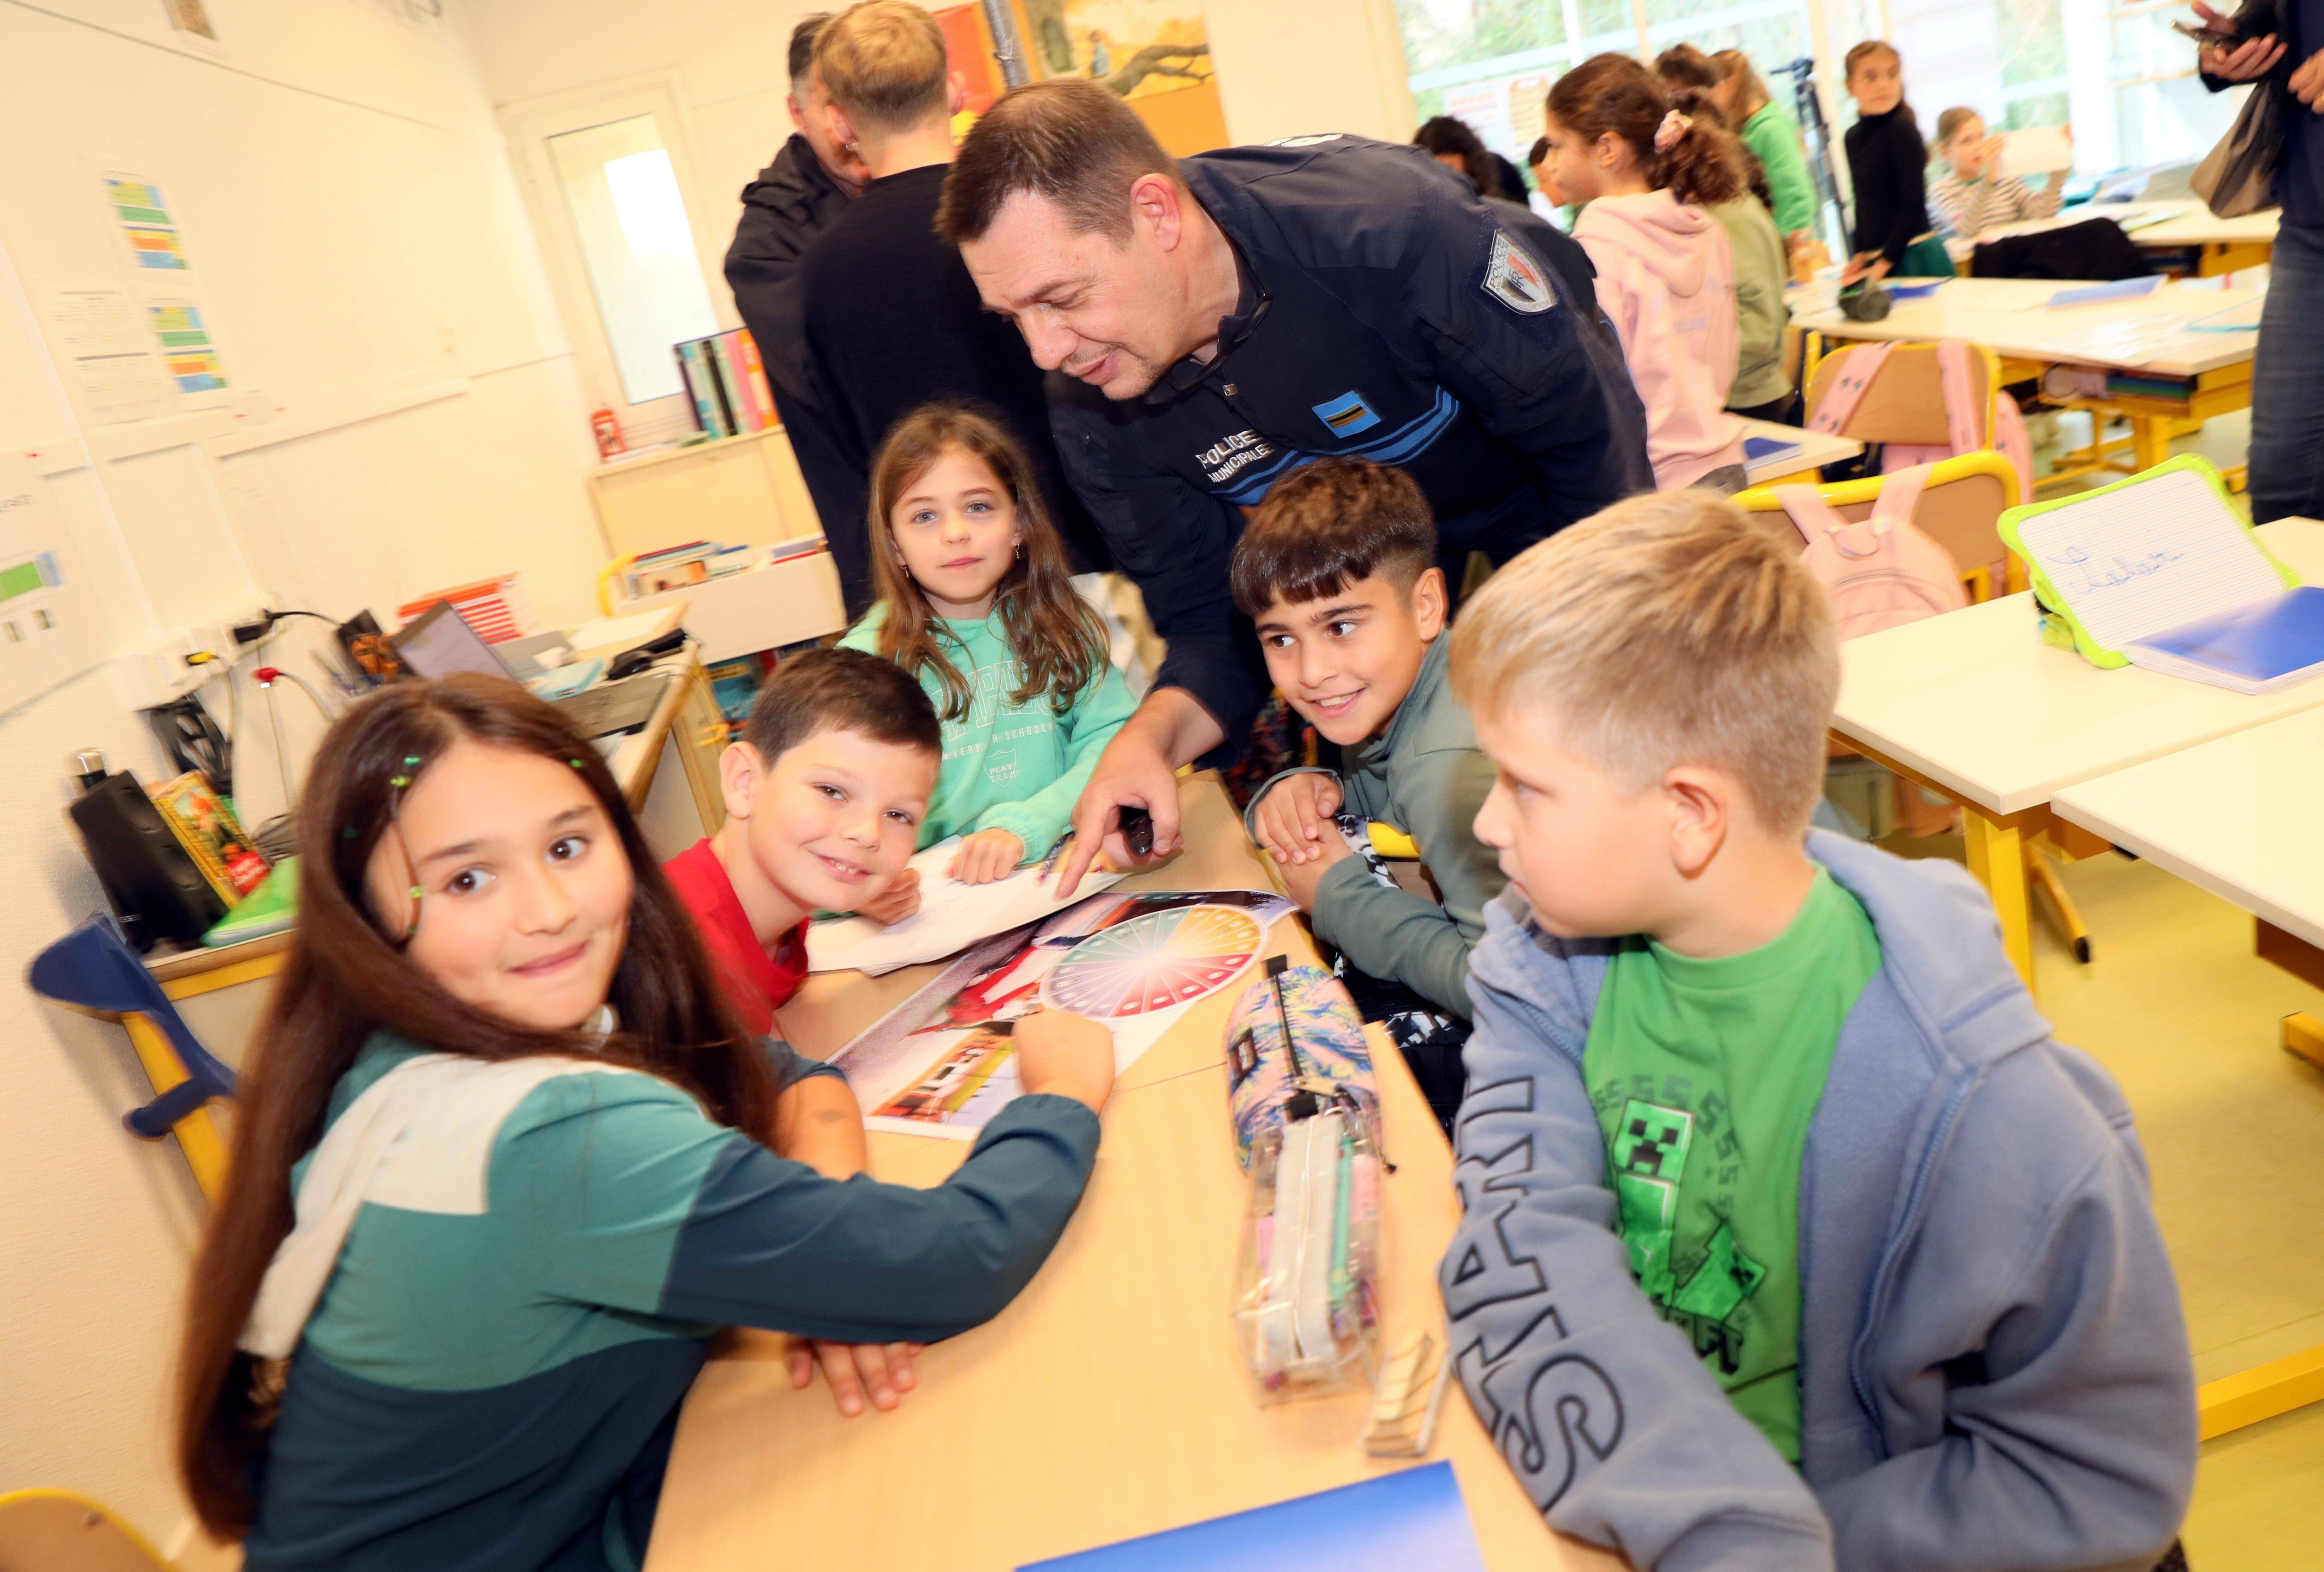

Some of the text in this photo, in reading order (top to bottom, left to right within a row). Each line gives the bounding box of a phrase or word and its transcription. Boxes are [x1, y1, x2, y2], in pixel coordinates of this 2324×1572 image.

[1490, 237, 1505, 288] POLICE
[1195, 430, 1258, 469] POLICE
[1207, 444, 1270, 483] MUNICIPALE
[951, 743, 981, 758] VERY
[1005, 723, 1047, 741] SCHOOL
[989, 763, 1013, 775] PLAY
[990, 771, 1017, 783] TEAM
